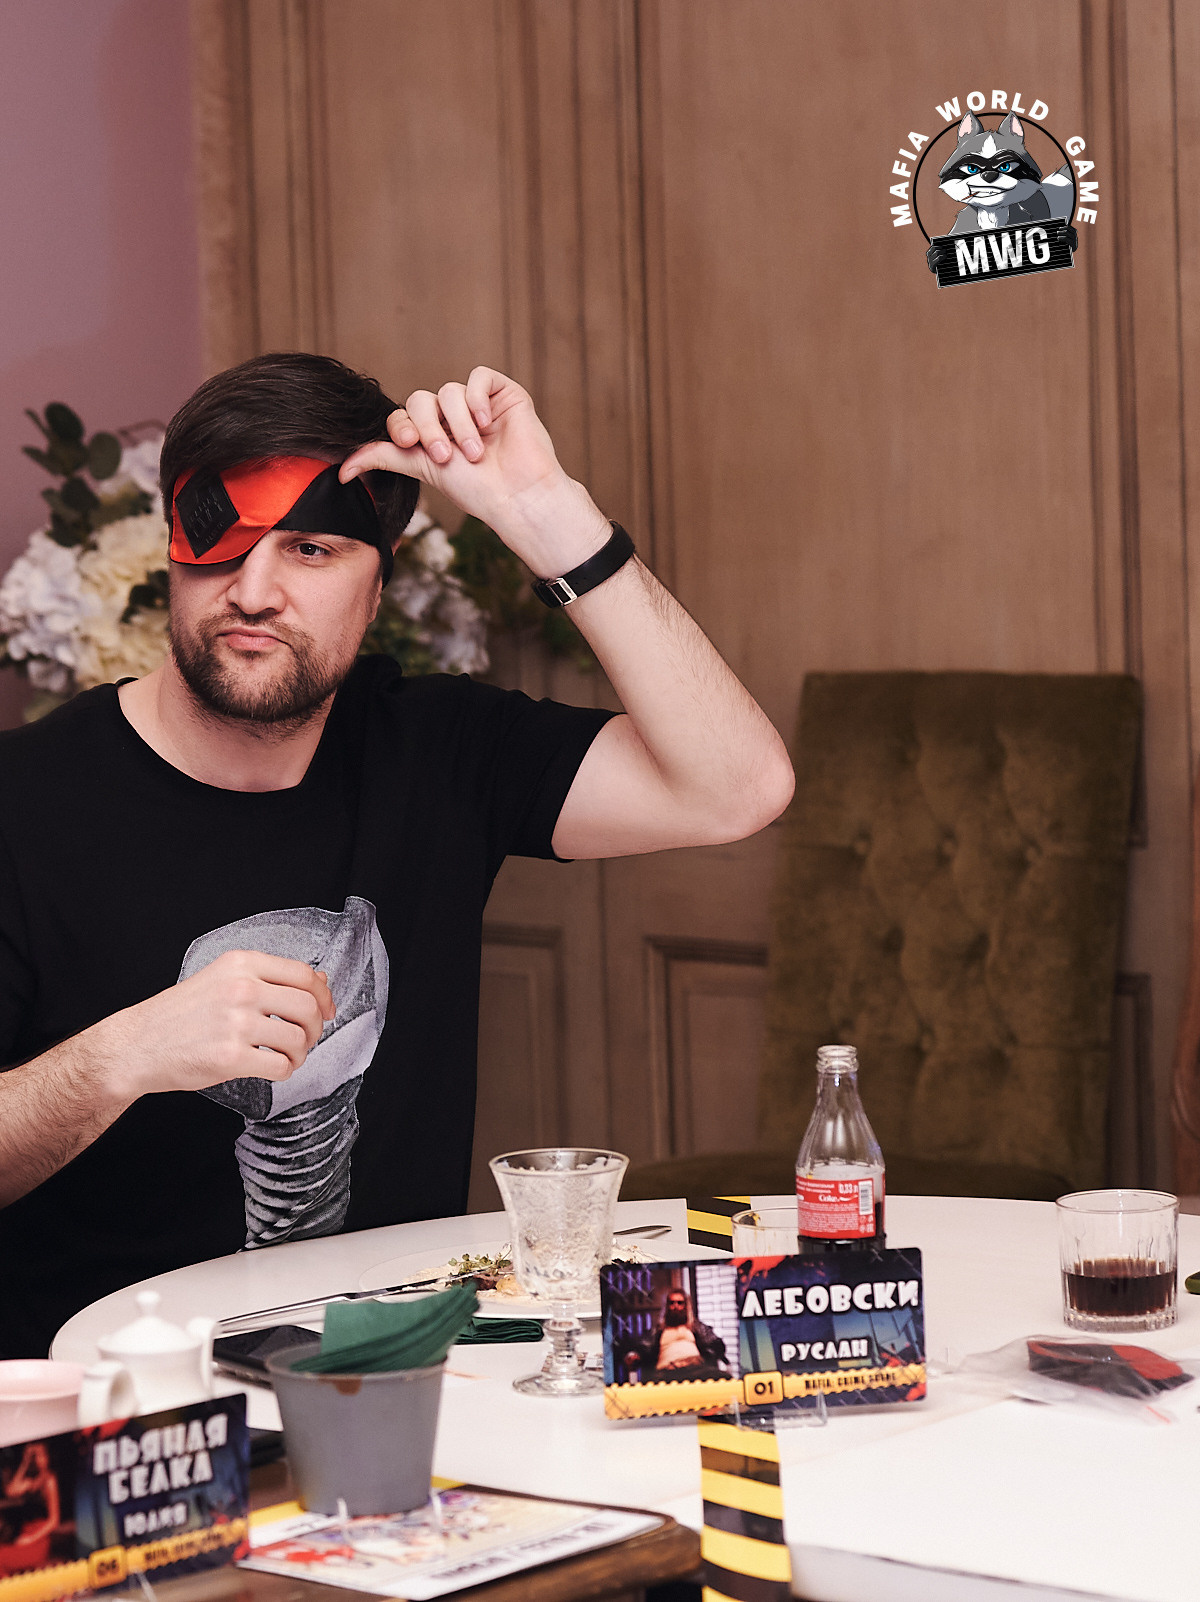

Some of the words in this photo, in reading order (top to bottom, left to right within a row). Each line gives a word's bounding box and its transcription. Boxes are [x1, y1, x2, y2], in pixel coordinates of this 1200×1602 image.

[741, 1280, 920, 1318] ЛЕБОВСКИ
[781, 1339, 869, 1362] РУСЛАН
[754, 1381, 774, 1395] 01
[93, 1413, 228, 1475] ПЬЯНАЯ
[108, 1450, 213, 1504] БЕЛКА
